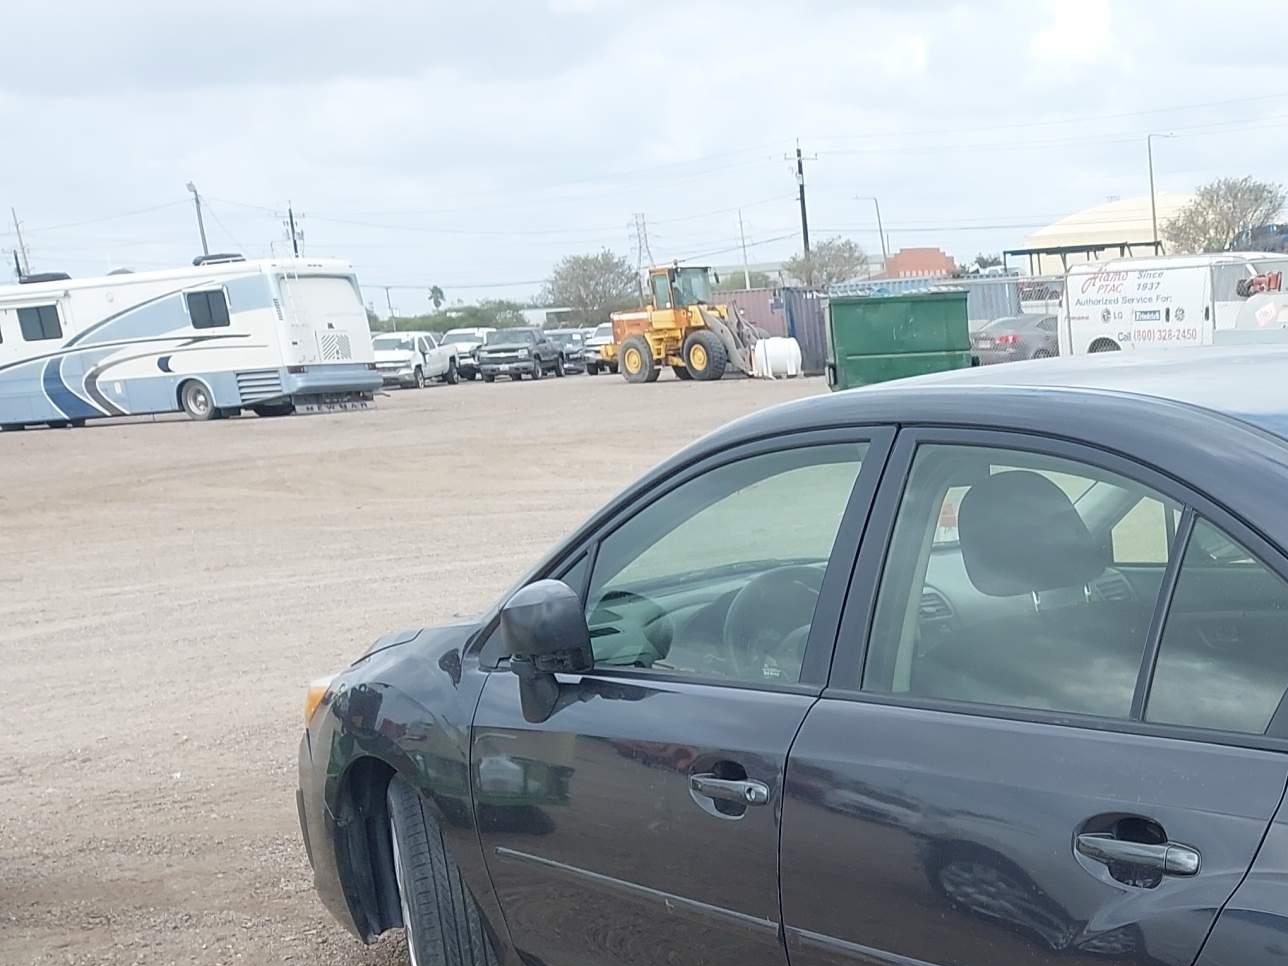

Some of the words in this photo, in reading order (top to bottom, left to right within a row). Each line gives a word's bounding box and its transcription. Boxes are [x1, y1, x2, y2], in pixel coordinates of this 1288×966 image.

[1137, 271, 1164, 280] Since
[1097, 282, 1125, 293] PTAC
[1136, 282, 1161, 291] 1937
[1075, 296, 1119, 306] Authorized
[1121, 296, 1153, 305] Service
[1117, 331, 1132, 342] Call
[1133, 329, 1156, 342] (800)
